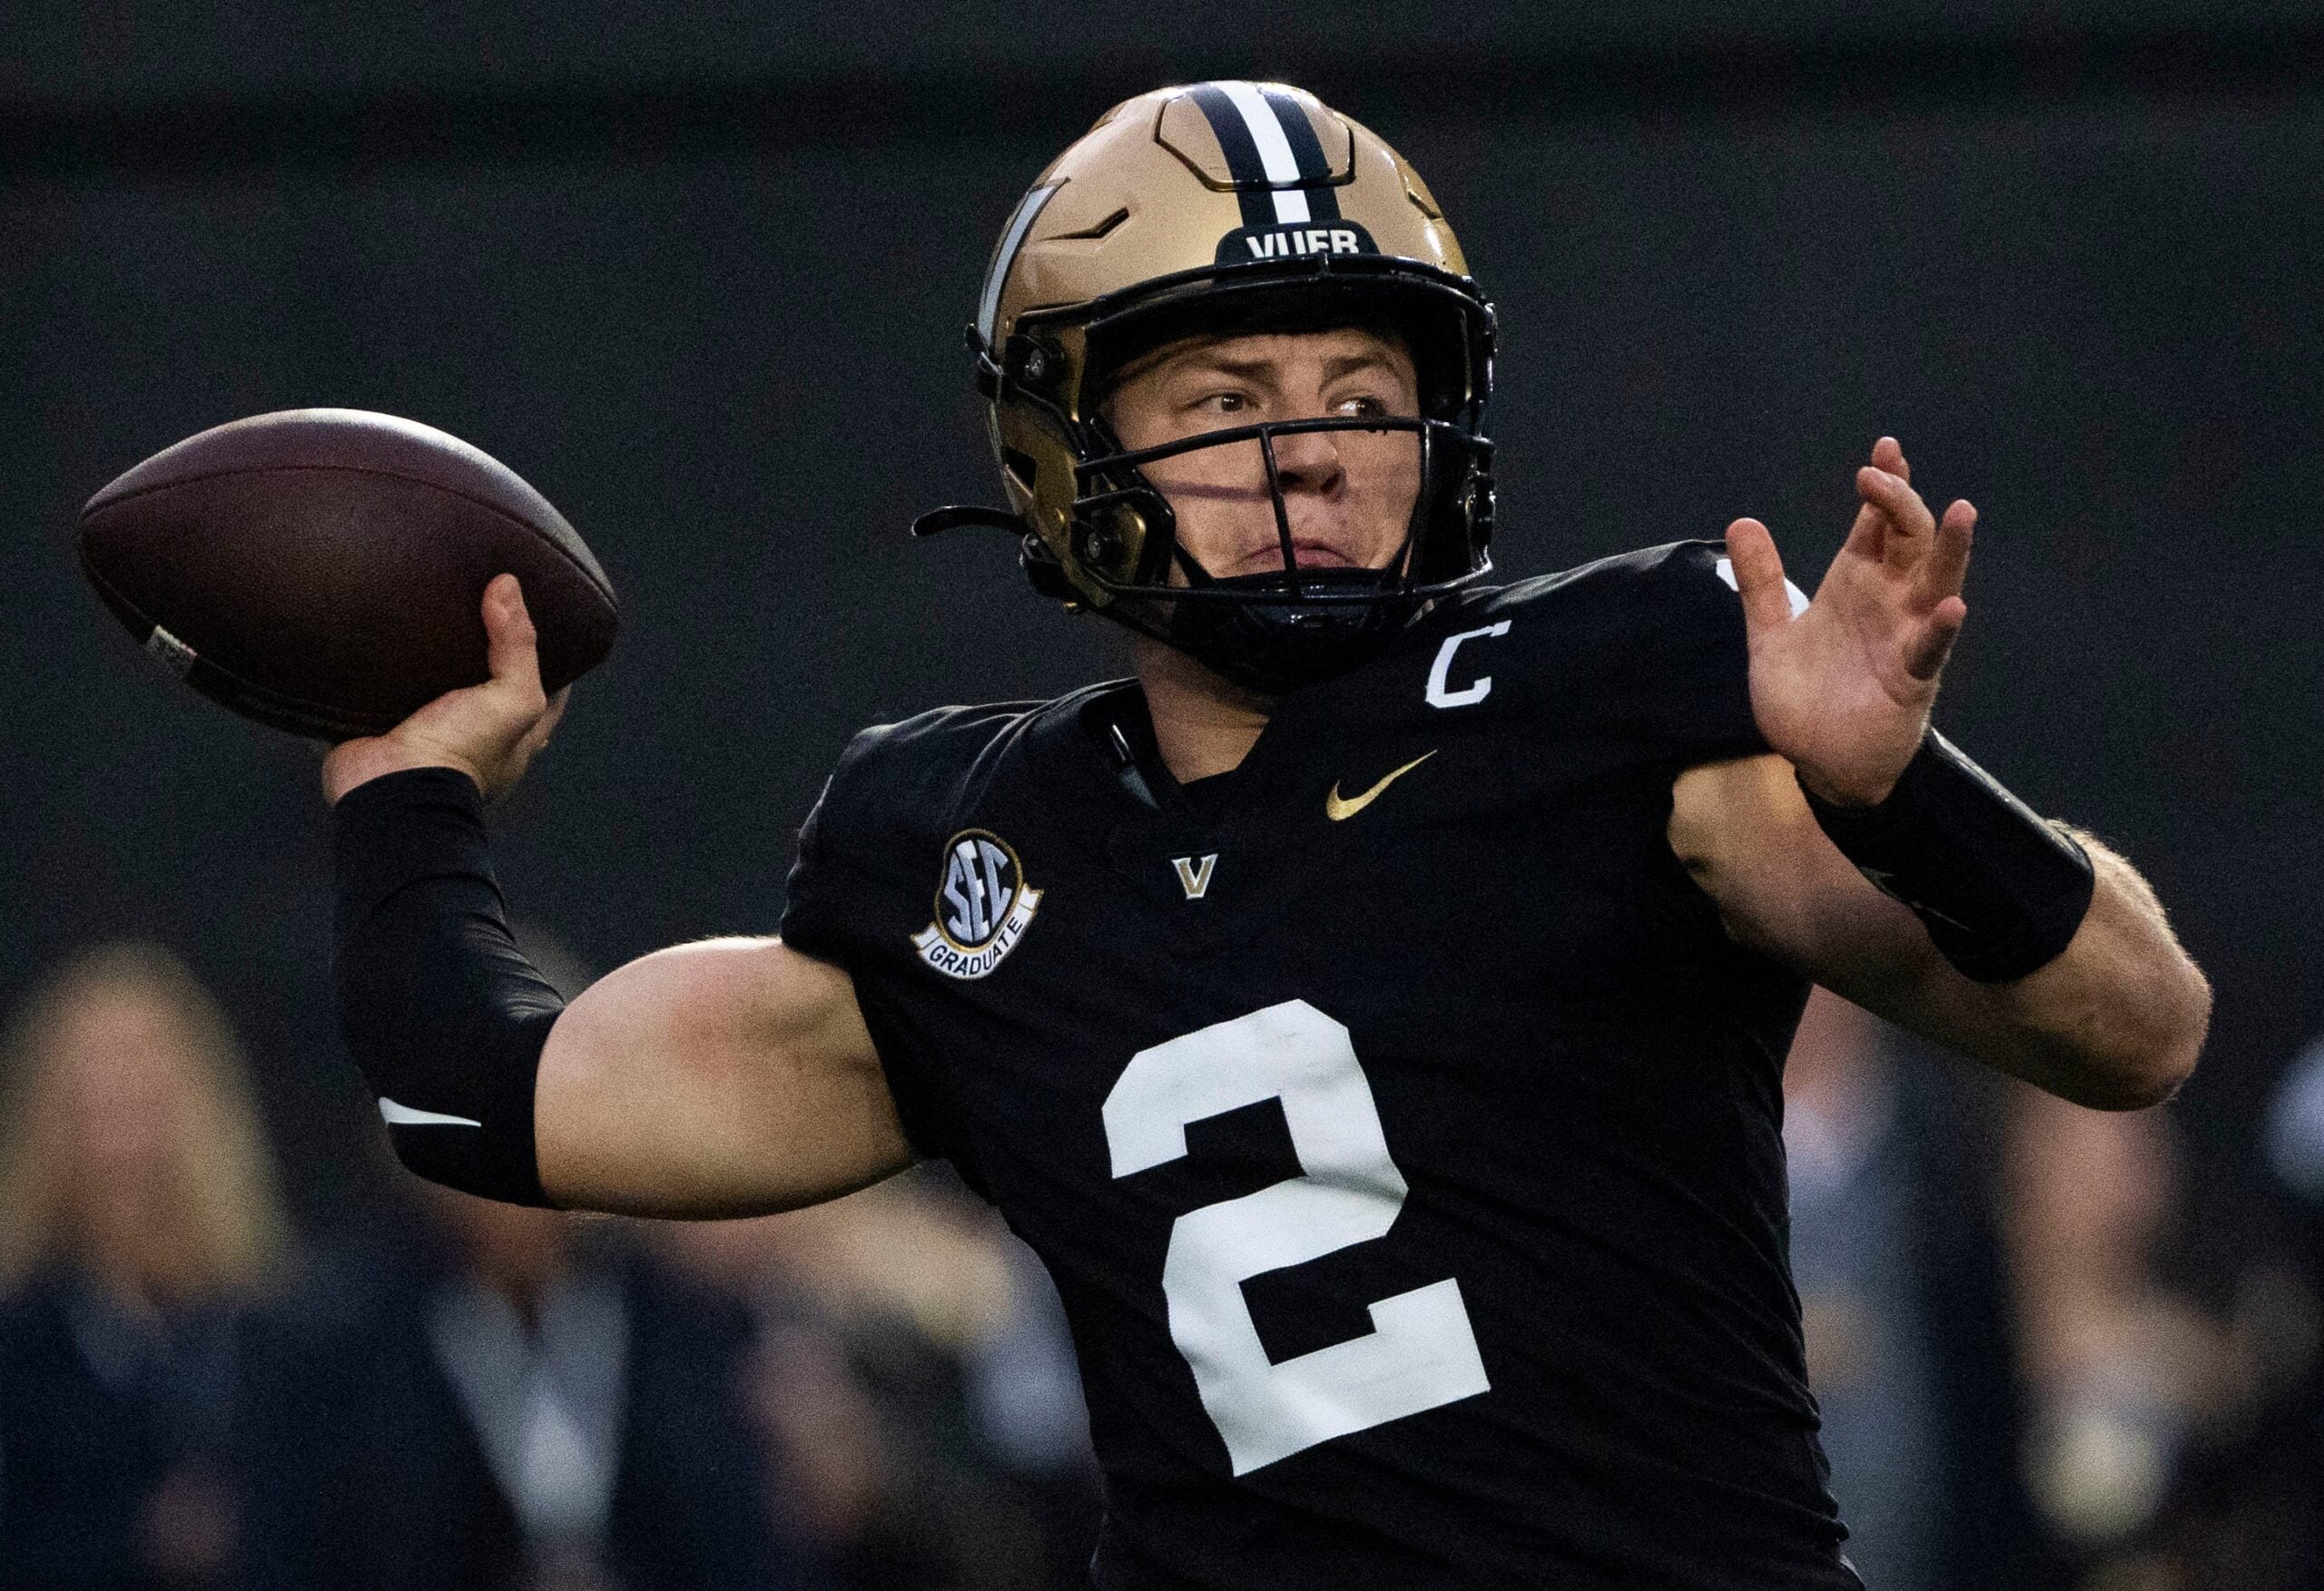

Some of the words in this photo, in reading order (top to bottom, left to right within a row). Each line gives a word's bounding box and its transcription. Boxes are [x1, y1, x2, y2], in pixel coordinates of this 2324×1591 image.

[1424, 619, 1512, 710] C
[943, 839, 1013, 943] SEC
[1171, 852, 1219, 900] V
[929, 916, 1023, 977] GRADUATE
[1100, 997, 1492, 1478] 2
